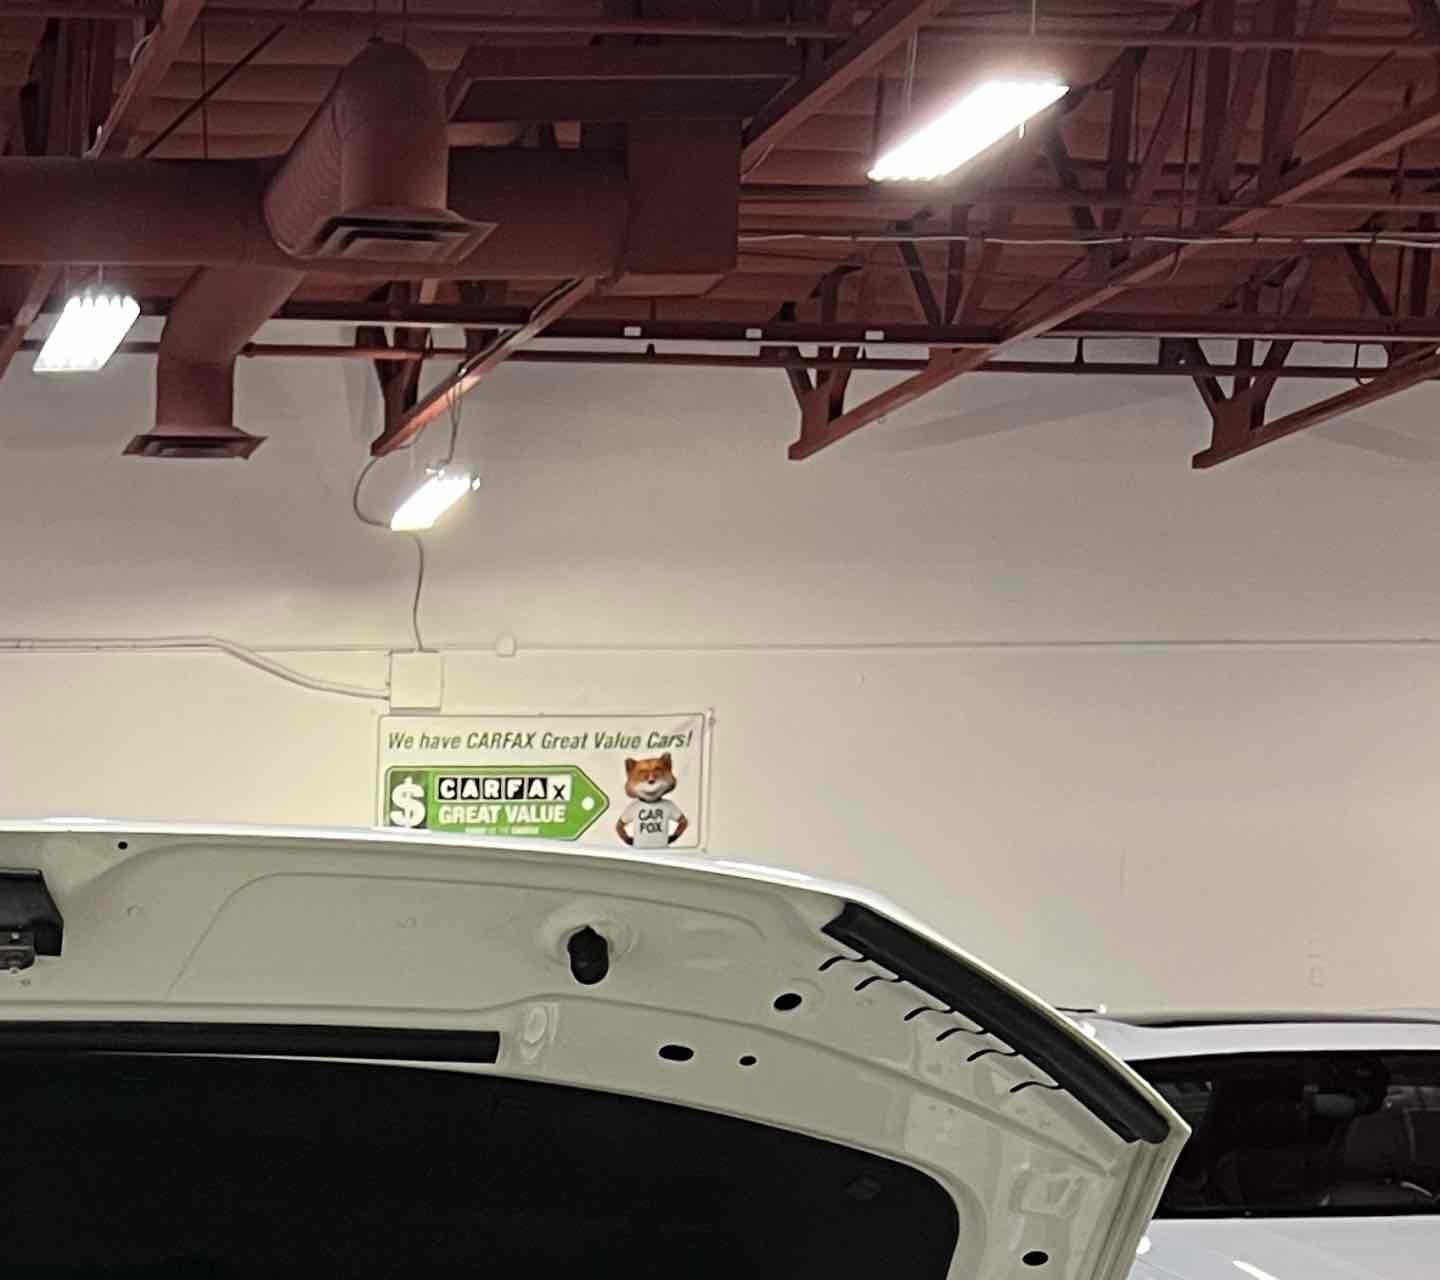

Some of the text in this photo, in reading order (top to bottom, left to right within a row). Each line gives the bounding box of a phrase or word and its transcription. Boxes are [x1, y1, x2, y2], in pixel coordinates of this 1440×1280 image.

[388, 729, 693, 750] We have CARFAX Great Value Cars!
[438, 776, 567, 801] CARFAX
[438, 804, 566, 824] GREAT VALUE
[638, 808, 664, 821] CAR
[639, 822, 663, 835] FOX
